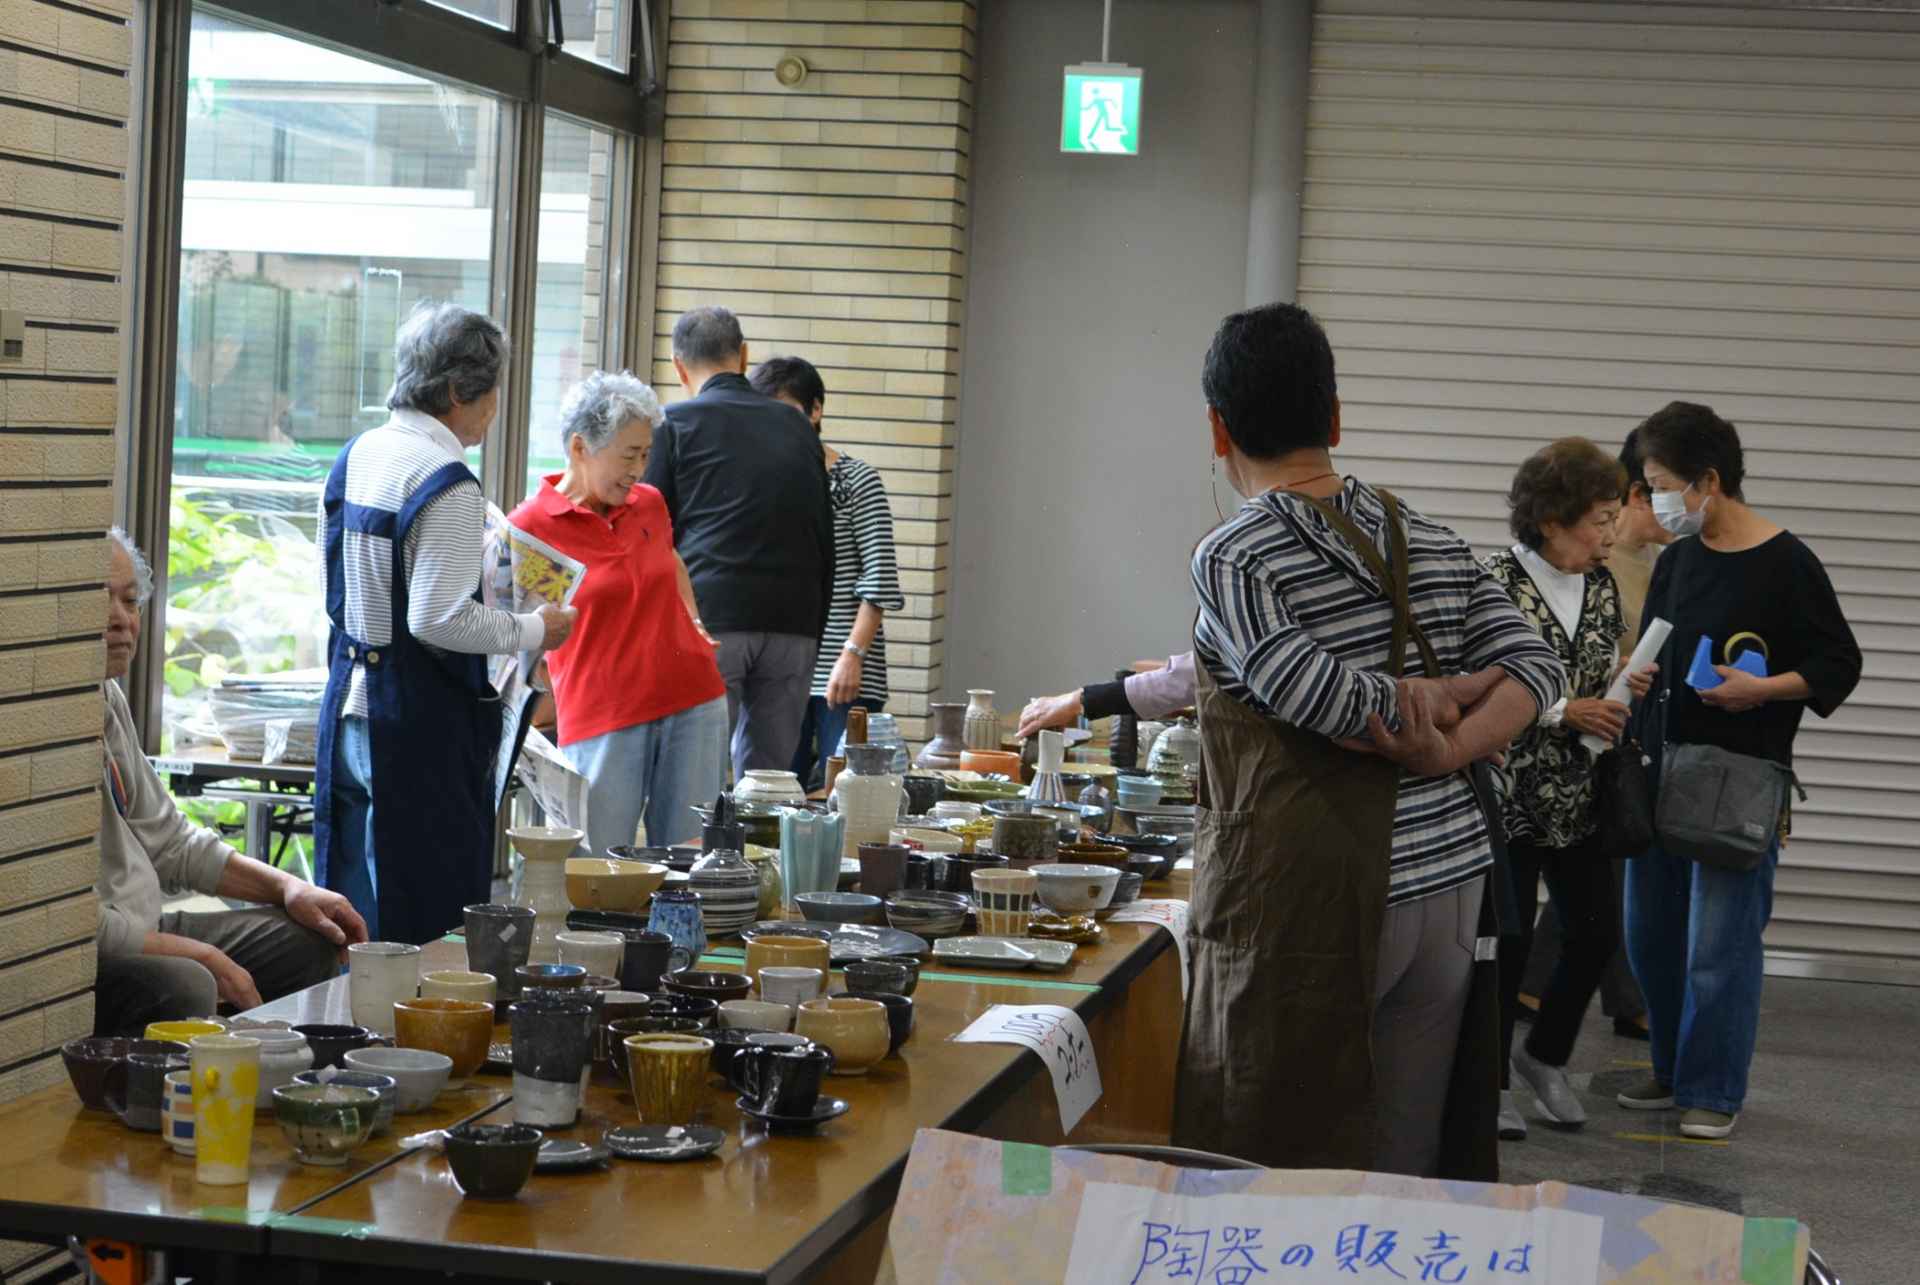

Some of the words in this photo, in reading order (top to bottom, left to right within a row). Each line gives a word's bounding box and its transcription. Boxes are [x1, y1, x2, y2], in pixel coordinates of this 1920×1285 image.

[1132, 1222, 1536, 1285] 陶器の販売は
